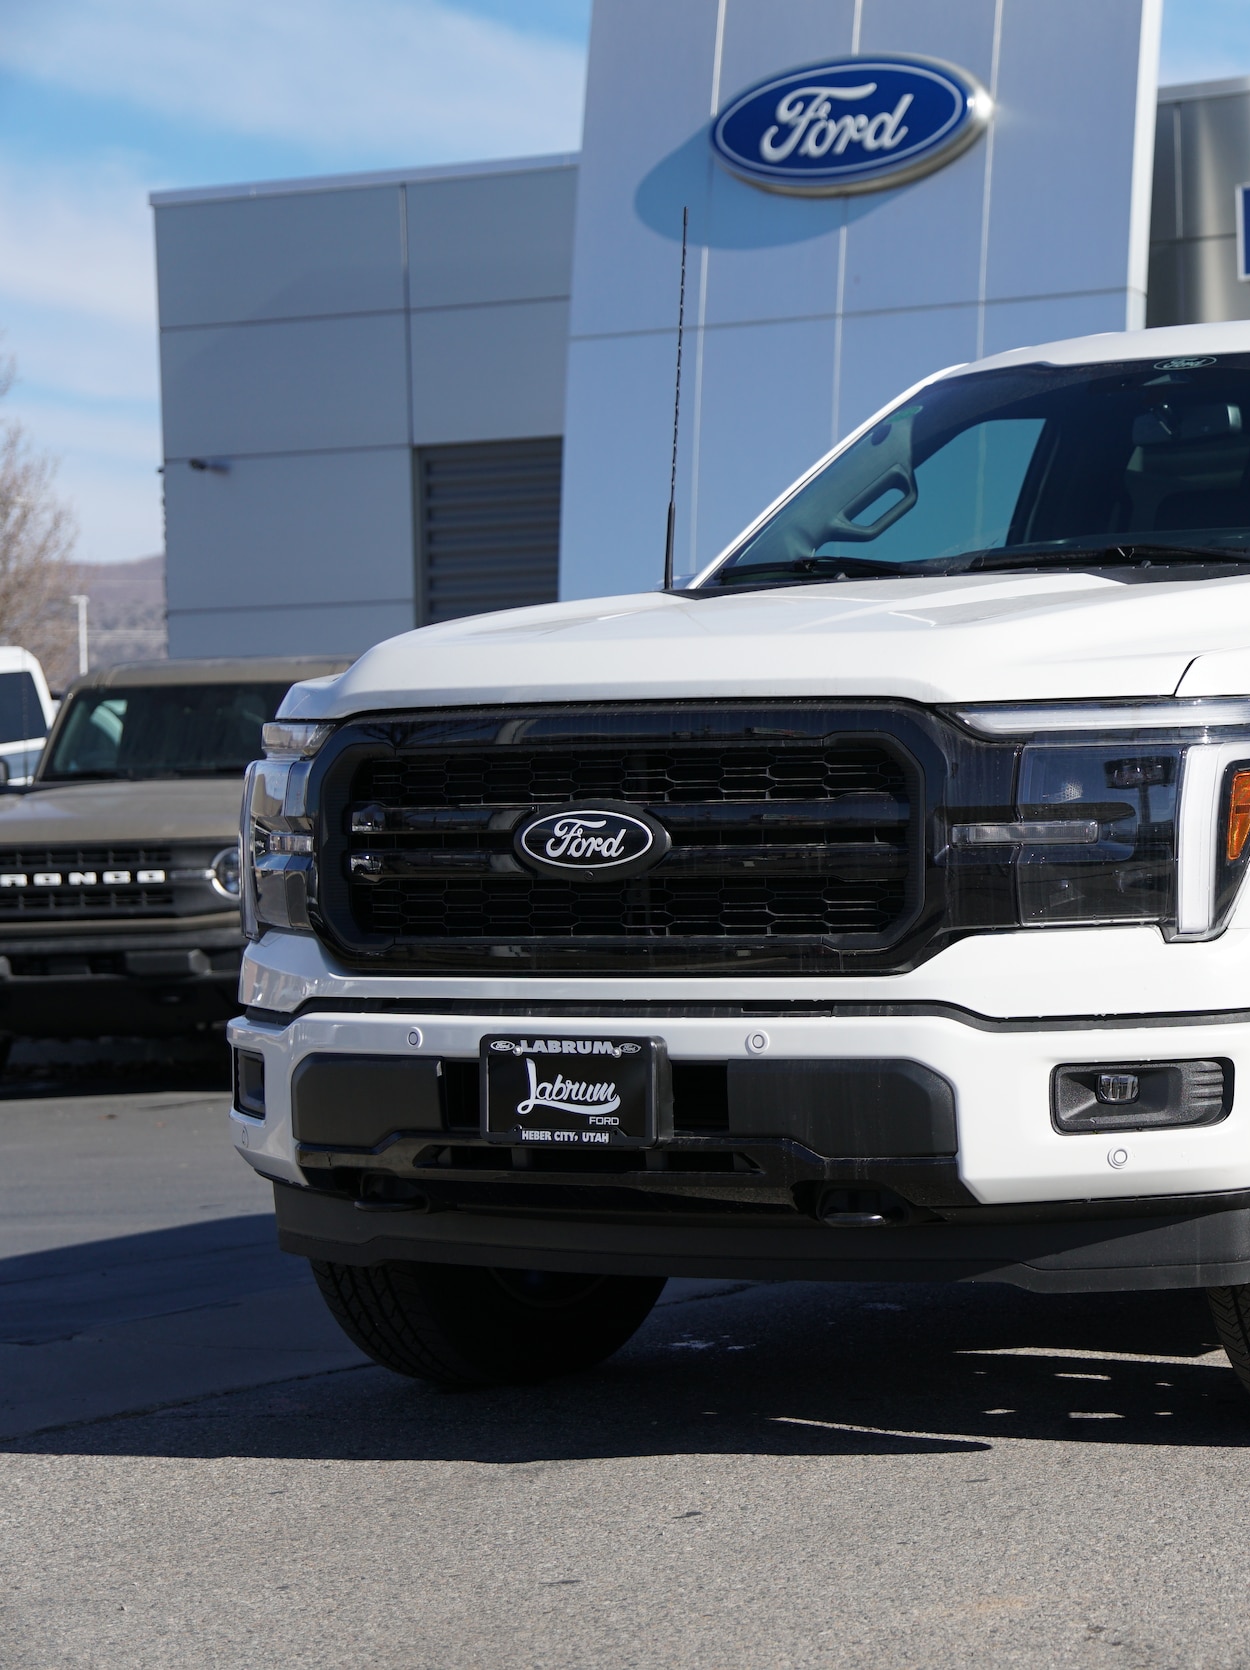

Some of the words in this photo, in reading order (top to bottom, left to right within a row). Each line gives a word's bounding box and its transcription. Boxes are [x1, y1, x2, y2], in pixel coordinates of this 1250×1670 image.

[760, 82, 914, 163] Ford
[1162, 358, 1207, 369] Ford
[546, 818, 627, 858] Ford
[520, 1040, 614, 1055] LABRUM
[517, 1058, 621, 1114] Labrum
[589, 1116, 619, 1125] FORD
[522, 1130, 551, 1141] HEBER
[554, 1131, 579, 1142] CITY,
[582, 1132, 609, 1143] UTAH
